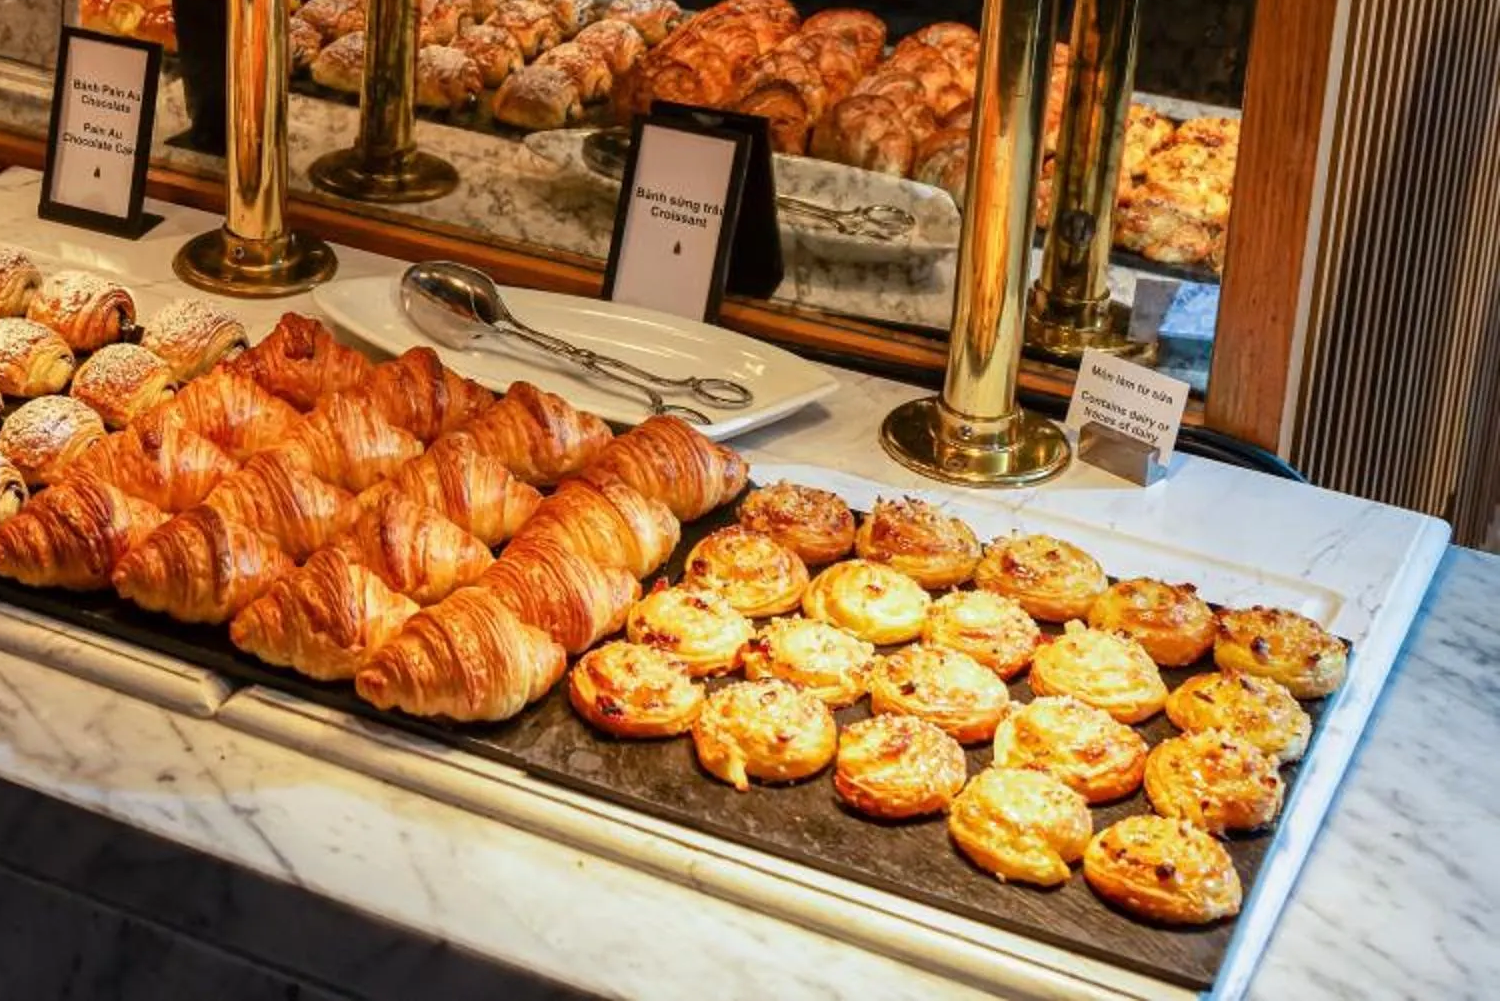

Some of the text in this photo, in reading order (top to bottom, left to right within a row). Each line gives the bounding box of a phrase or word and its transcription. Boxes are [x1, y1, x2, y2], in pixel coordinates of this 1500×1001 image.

[81, 94, 131, 114] Chocolate
[83, 122, 105, 136] Pain
[62, 131, 112, 152] Chocolate
[635, 185, 667, 205] Bánh
[650, 205, 707, 229] Croissant
[1081, 390, 1127, 417] Contains
[1118, 420, 1131, 431] of
